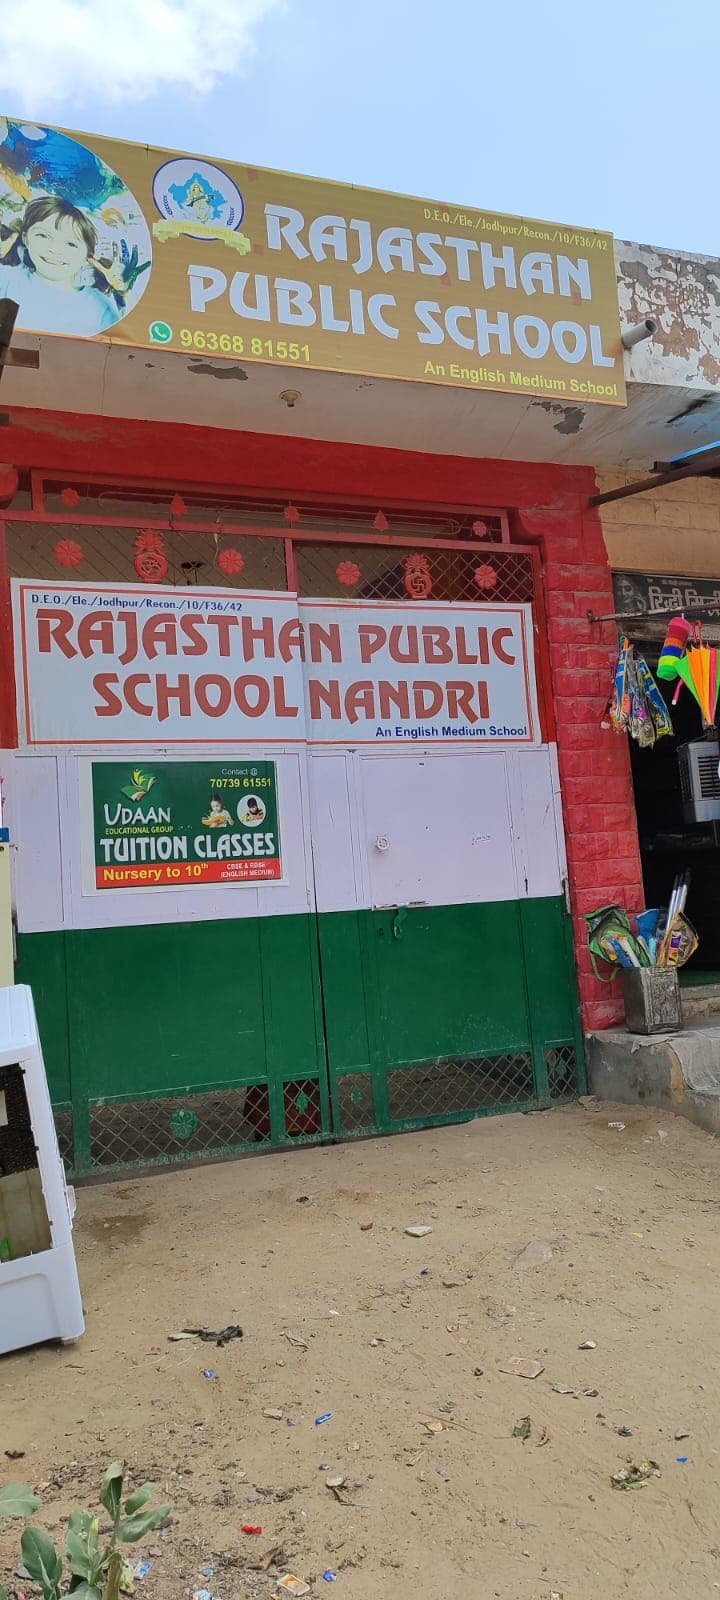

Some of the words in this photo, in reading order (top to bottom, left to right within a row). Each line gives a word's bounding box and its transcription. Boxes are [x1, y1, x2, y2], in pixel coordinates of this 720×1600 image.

[264, 203, 592, 300] RAJASTHAN
[187, 264, 400, 339] PUBLIC
[414, 300, 616, 368] SCHOOL
[179, 328, 244, 354] 96368
[251, 337, 311, 361] 81551
[423, 360, 446, 377] An
[449, 363, 506, 383] English
[509, 371, 567, 391] Medium
[569, 378, 618, 397] School
[31, 593, 243, 612] D.E.O./Ele./Jodhpur/Recon./10/F36/42
[36, 608, 342, 666] RAJASTHAN
[357, 624, 517, 666] PUBLIC
[92, 672, 299, 723] SCHOOL
[308, 679, 491, 725] NANDRI
[375, 726, 392, 738] An
[395, 726, 439, 739] English
[441, 725, 487, 737] Medium
[489, 725, 528, 737] School
[210, 778, 241, 789] 70739
[243, 777, 271, 788] 61551
[221, 767, 249, 776] Contact
[103, 803, 171, 825] UDAAN
[105, 826, 150, 835] EDUCATIONAL
[151, 825, 174, 834] GROUP
[100, 835, 188, 863] TUITION
[193, 832, 276, 860] CLASSES
[103, 868, 163, 881] Nursery
[166, 866, 181, 878] to
[185, 863, 209, 877] 10th
